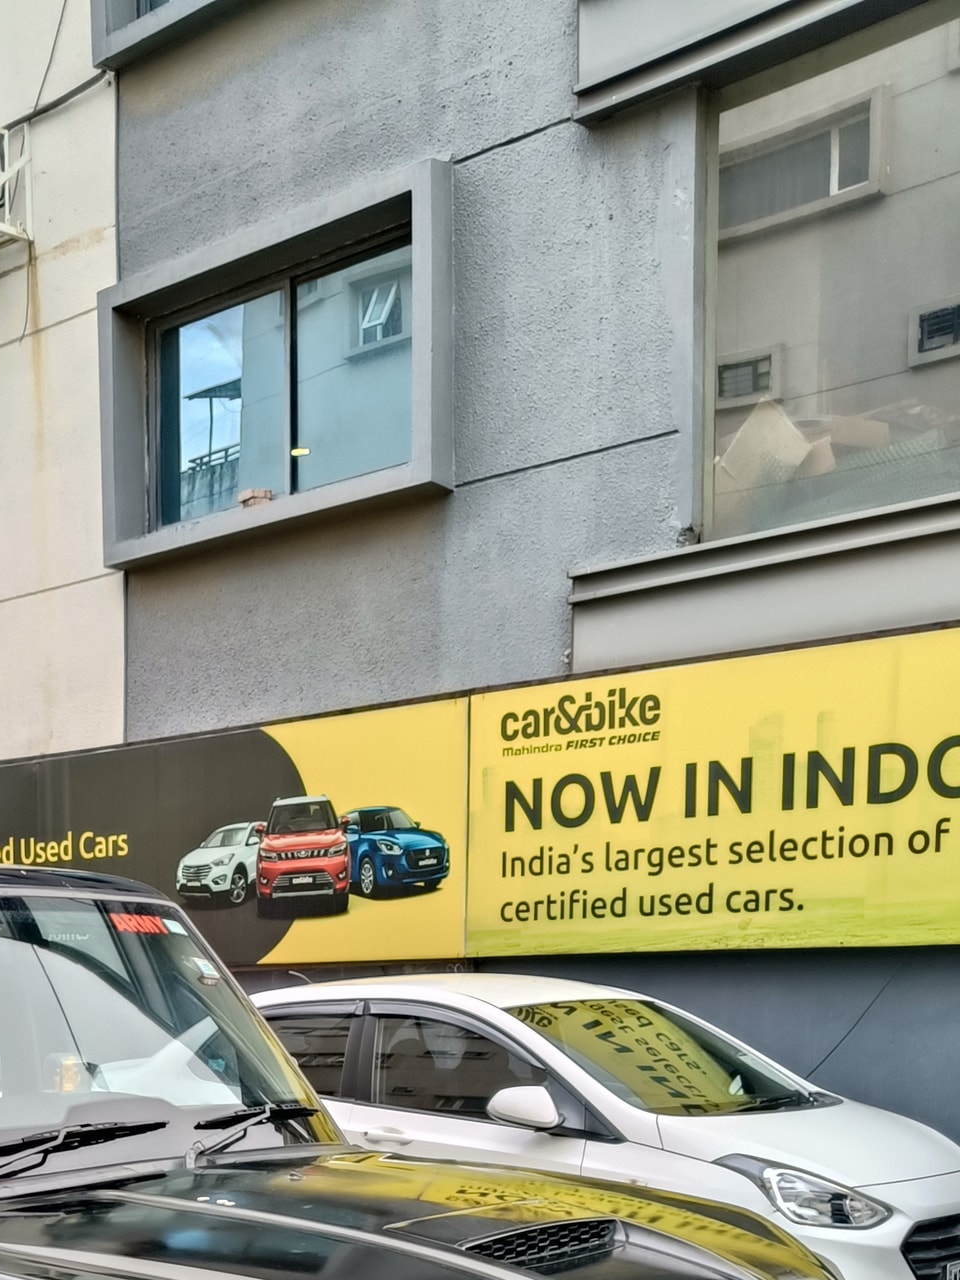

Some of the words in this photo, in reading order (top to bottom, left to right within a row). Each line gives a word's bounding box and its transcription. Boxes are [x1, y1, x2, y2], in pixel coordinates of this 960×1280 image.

[500, 687, 661, 742] car&bike
[502, 743, 562, 757] Mahindra
[565, 737, 606, 751] FIRST
[608, 730, 661, 747] CHOICE
[505, 766, 661, 833] NOW
[684, 756, 753, 818] IN
[781, 734, 960, 811] INDO
[20, 831, 73, 864] Used
[78, 831, 129, 860] Cars
[500, 843, 595, 879] India's
[604, 836, 719, 876] largest
[727, 825, 894, 863] selection
[907, 817, 951, 853] of
[500, 886, 628, 922] certified
[638, 882, 714, 917] used
[725, 886, 804, 913] cars.
[109, 912, 169, 935] ARMY
